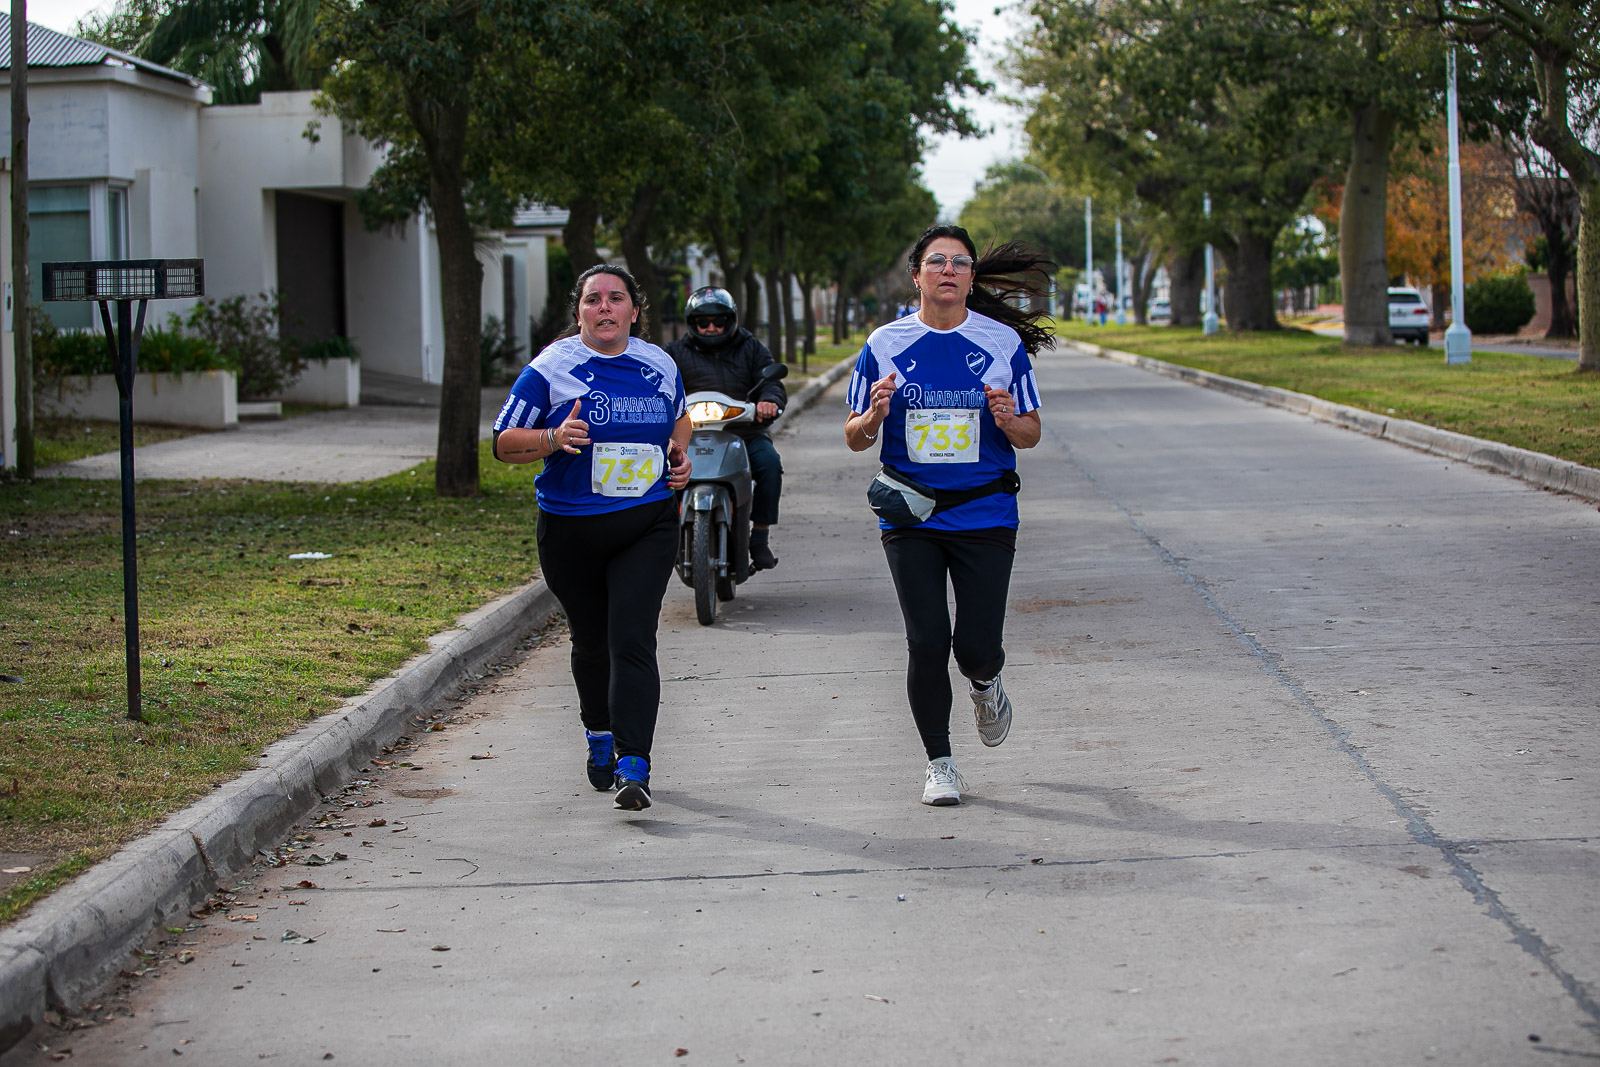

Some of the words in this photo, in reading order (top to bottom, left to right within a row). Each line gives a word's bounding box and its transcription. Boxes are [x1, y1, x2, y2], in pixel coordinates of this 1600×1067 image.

[589, 390, 610, 425] 3
[611, 395, 666, 412] MARATÓN
[903, 383, 922, 410] 3
[924, 388, 985, 408] MARATÓN
[932, 412, 938, 422] 3
[620, 446, 626, 456] 3
[913, 424, 971, 451] 733
[599, 458, 657, 485] 734
